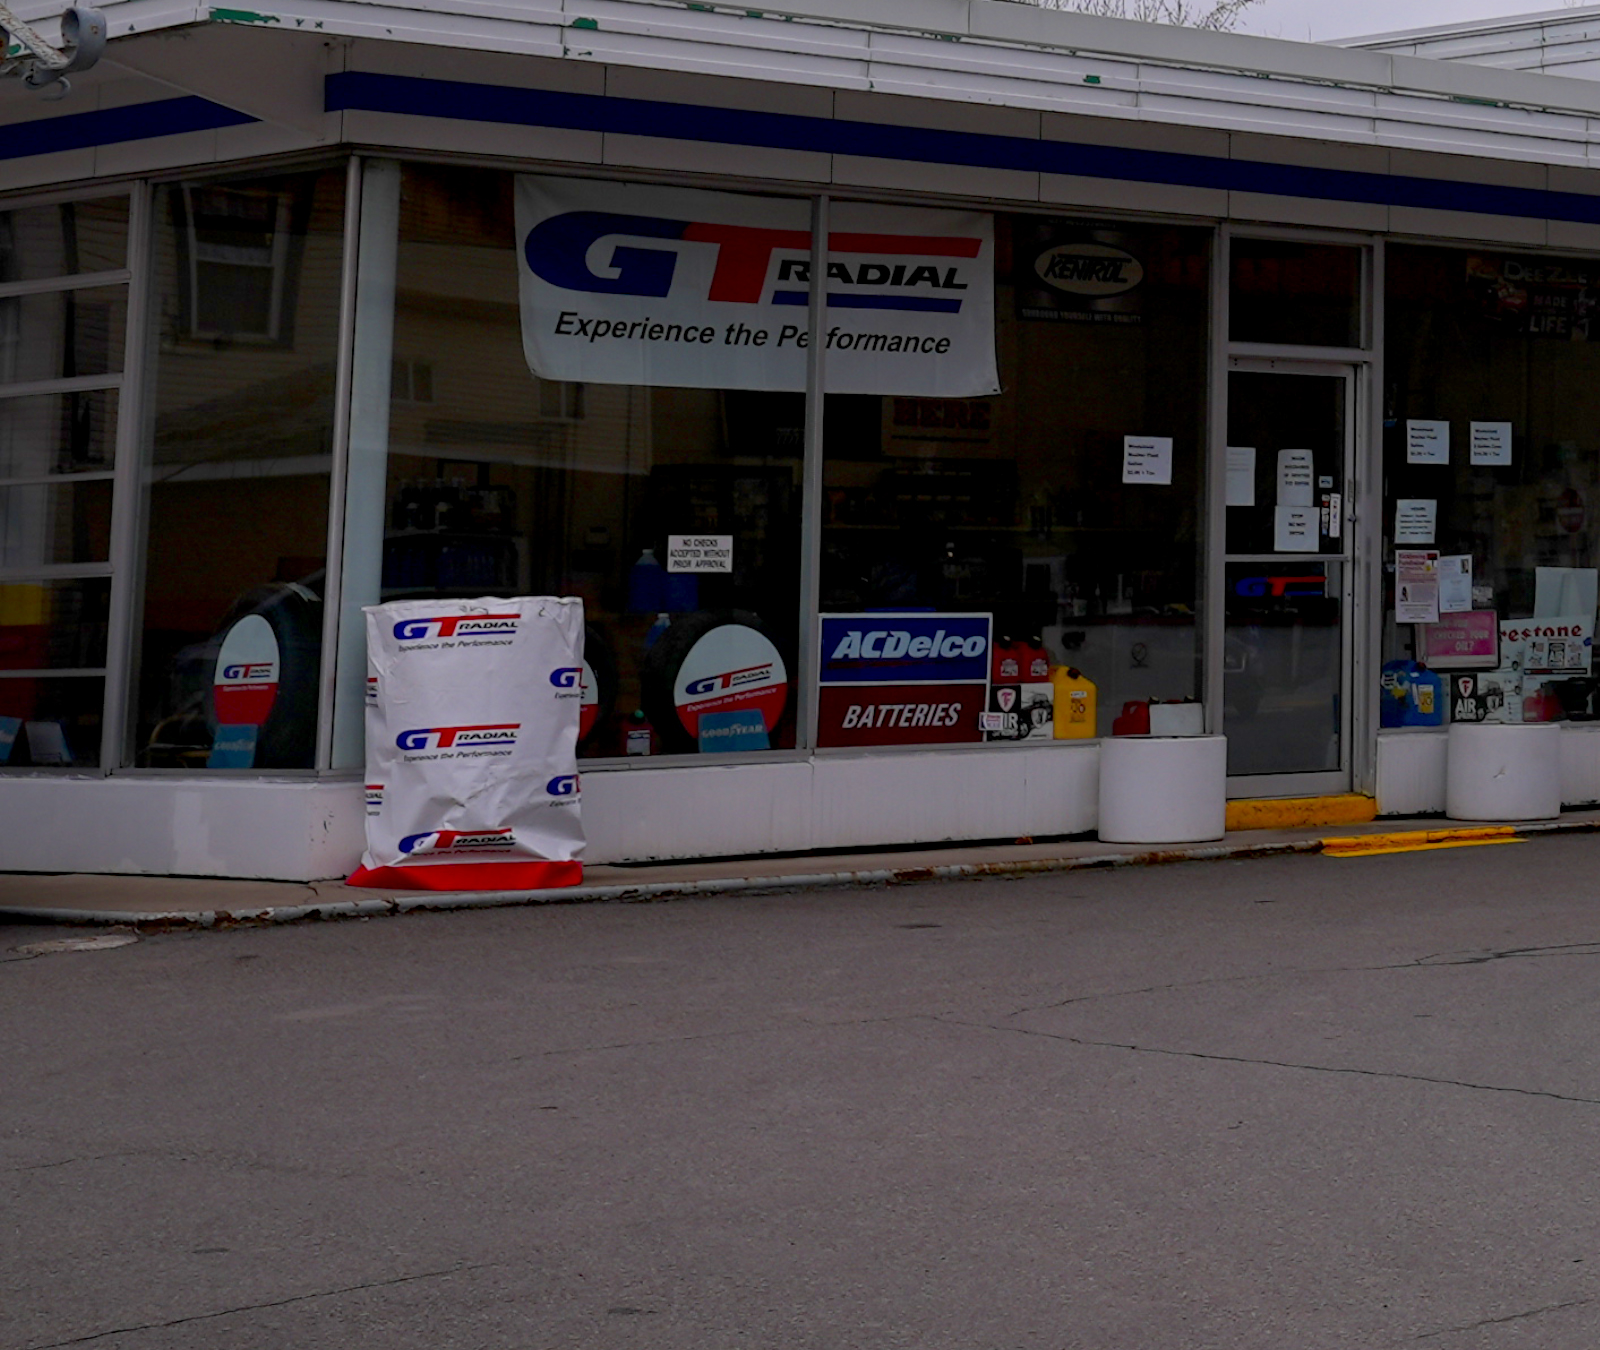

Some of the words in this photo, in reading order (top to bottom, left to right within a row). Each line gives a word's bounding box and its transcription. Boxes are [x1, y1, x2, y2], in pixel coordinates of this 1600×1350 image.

[777, 260, 968, 289] RADIAL
[555, 311, 715, 345] Experience
[724, 323, 768, 347] the
[777, 325, 951, 356] Peformance
[893, 398, 990, 429] HERE
[459, 621, 519, 630] RADIAL
[831, 630, 987, 659] ACDelco
[842, 703, 962, 729] BATTERIES
[457, 731, 518, 740] RADIAL
